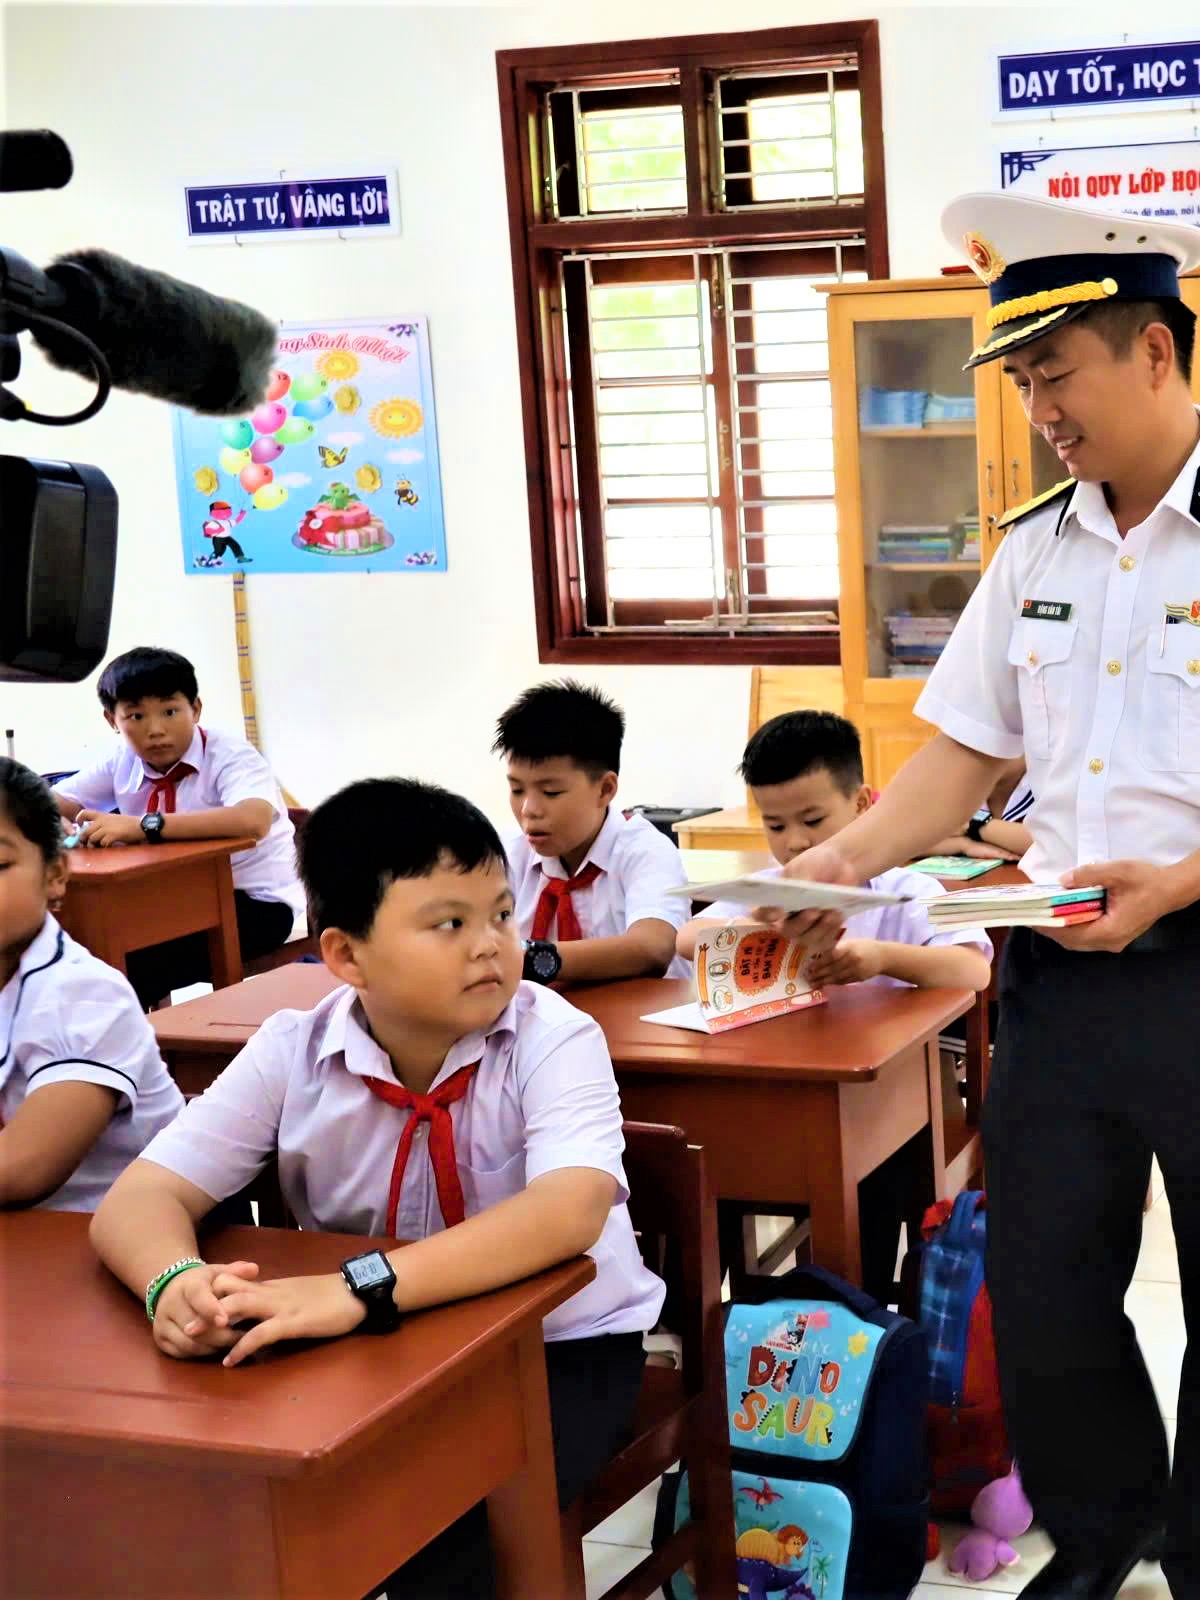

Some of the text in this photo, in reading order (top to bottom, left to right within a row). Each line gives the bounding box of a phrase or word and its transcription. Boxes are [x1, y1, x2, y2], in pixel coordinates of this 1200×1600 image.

[1008, 70, 1060, 102] DẠY
[1067, 55, 1125, 96] TỐT,
[1133, 60, 1187, 93] HỌC
[1086, 174, 1122, 199] QUY
[1128, 167, 1166, 194] LỚP
[195, 185, 384, 227] TRẬT TỰ, VÂNG LỜI
[732, 1388, 834, 1449] SAUR
